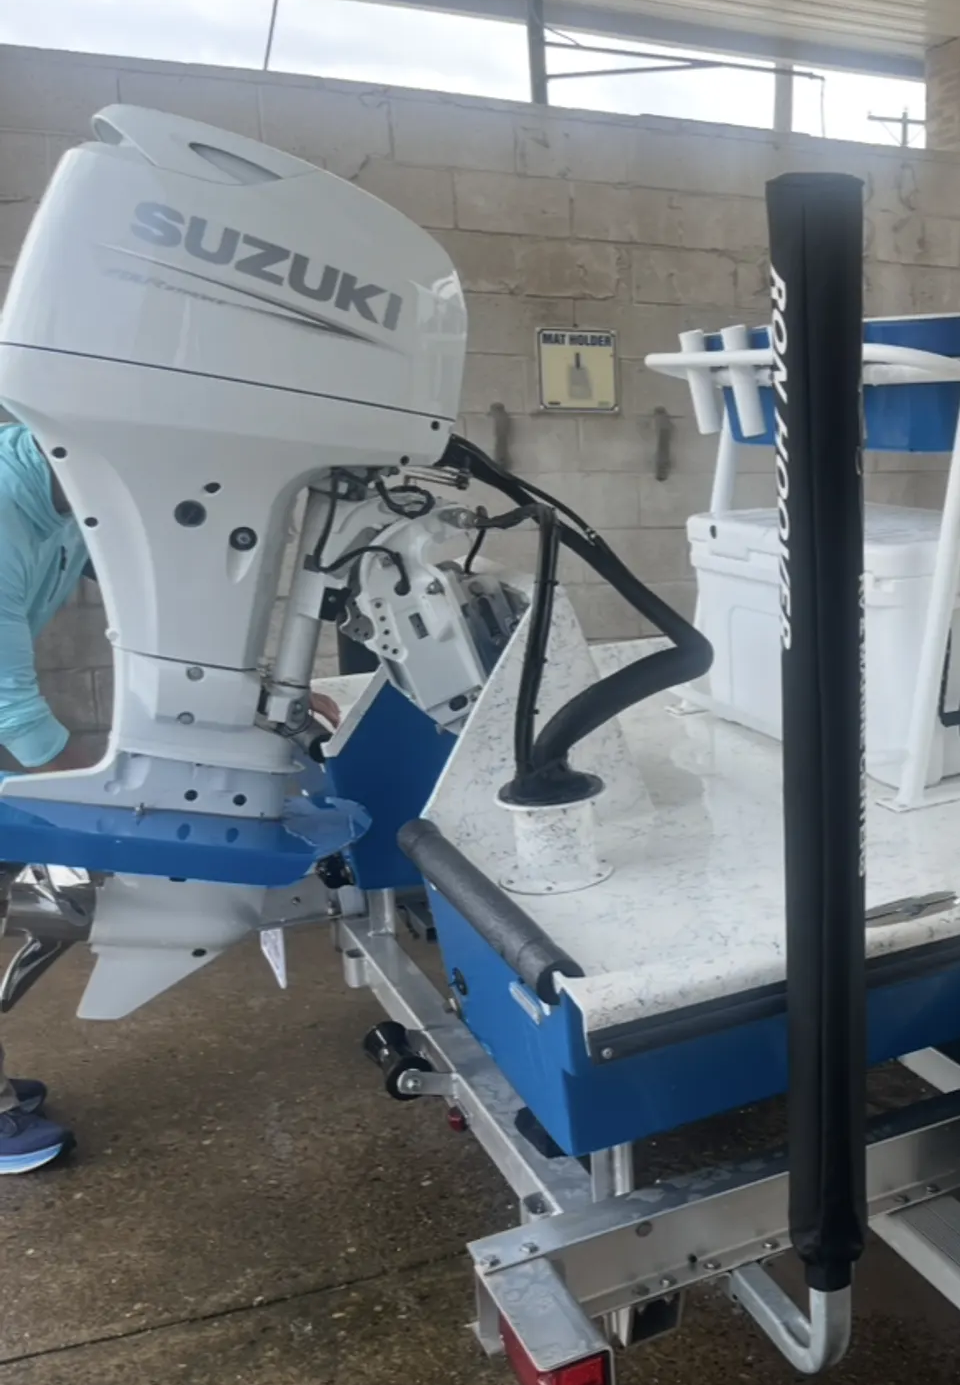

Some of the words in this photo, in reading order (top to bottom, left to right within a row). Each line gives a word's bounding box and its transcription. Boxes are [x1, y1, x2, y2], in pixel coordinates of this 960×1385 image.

[130, 200, 403, 332] SUZUKI
[542, 333, 565, 344] MAT
[569, 334, 612, 347] HOLDER
[770, 264, 788, 404] RON
